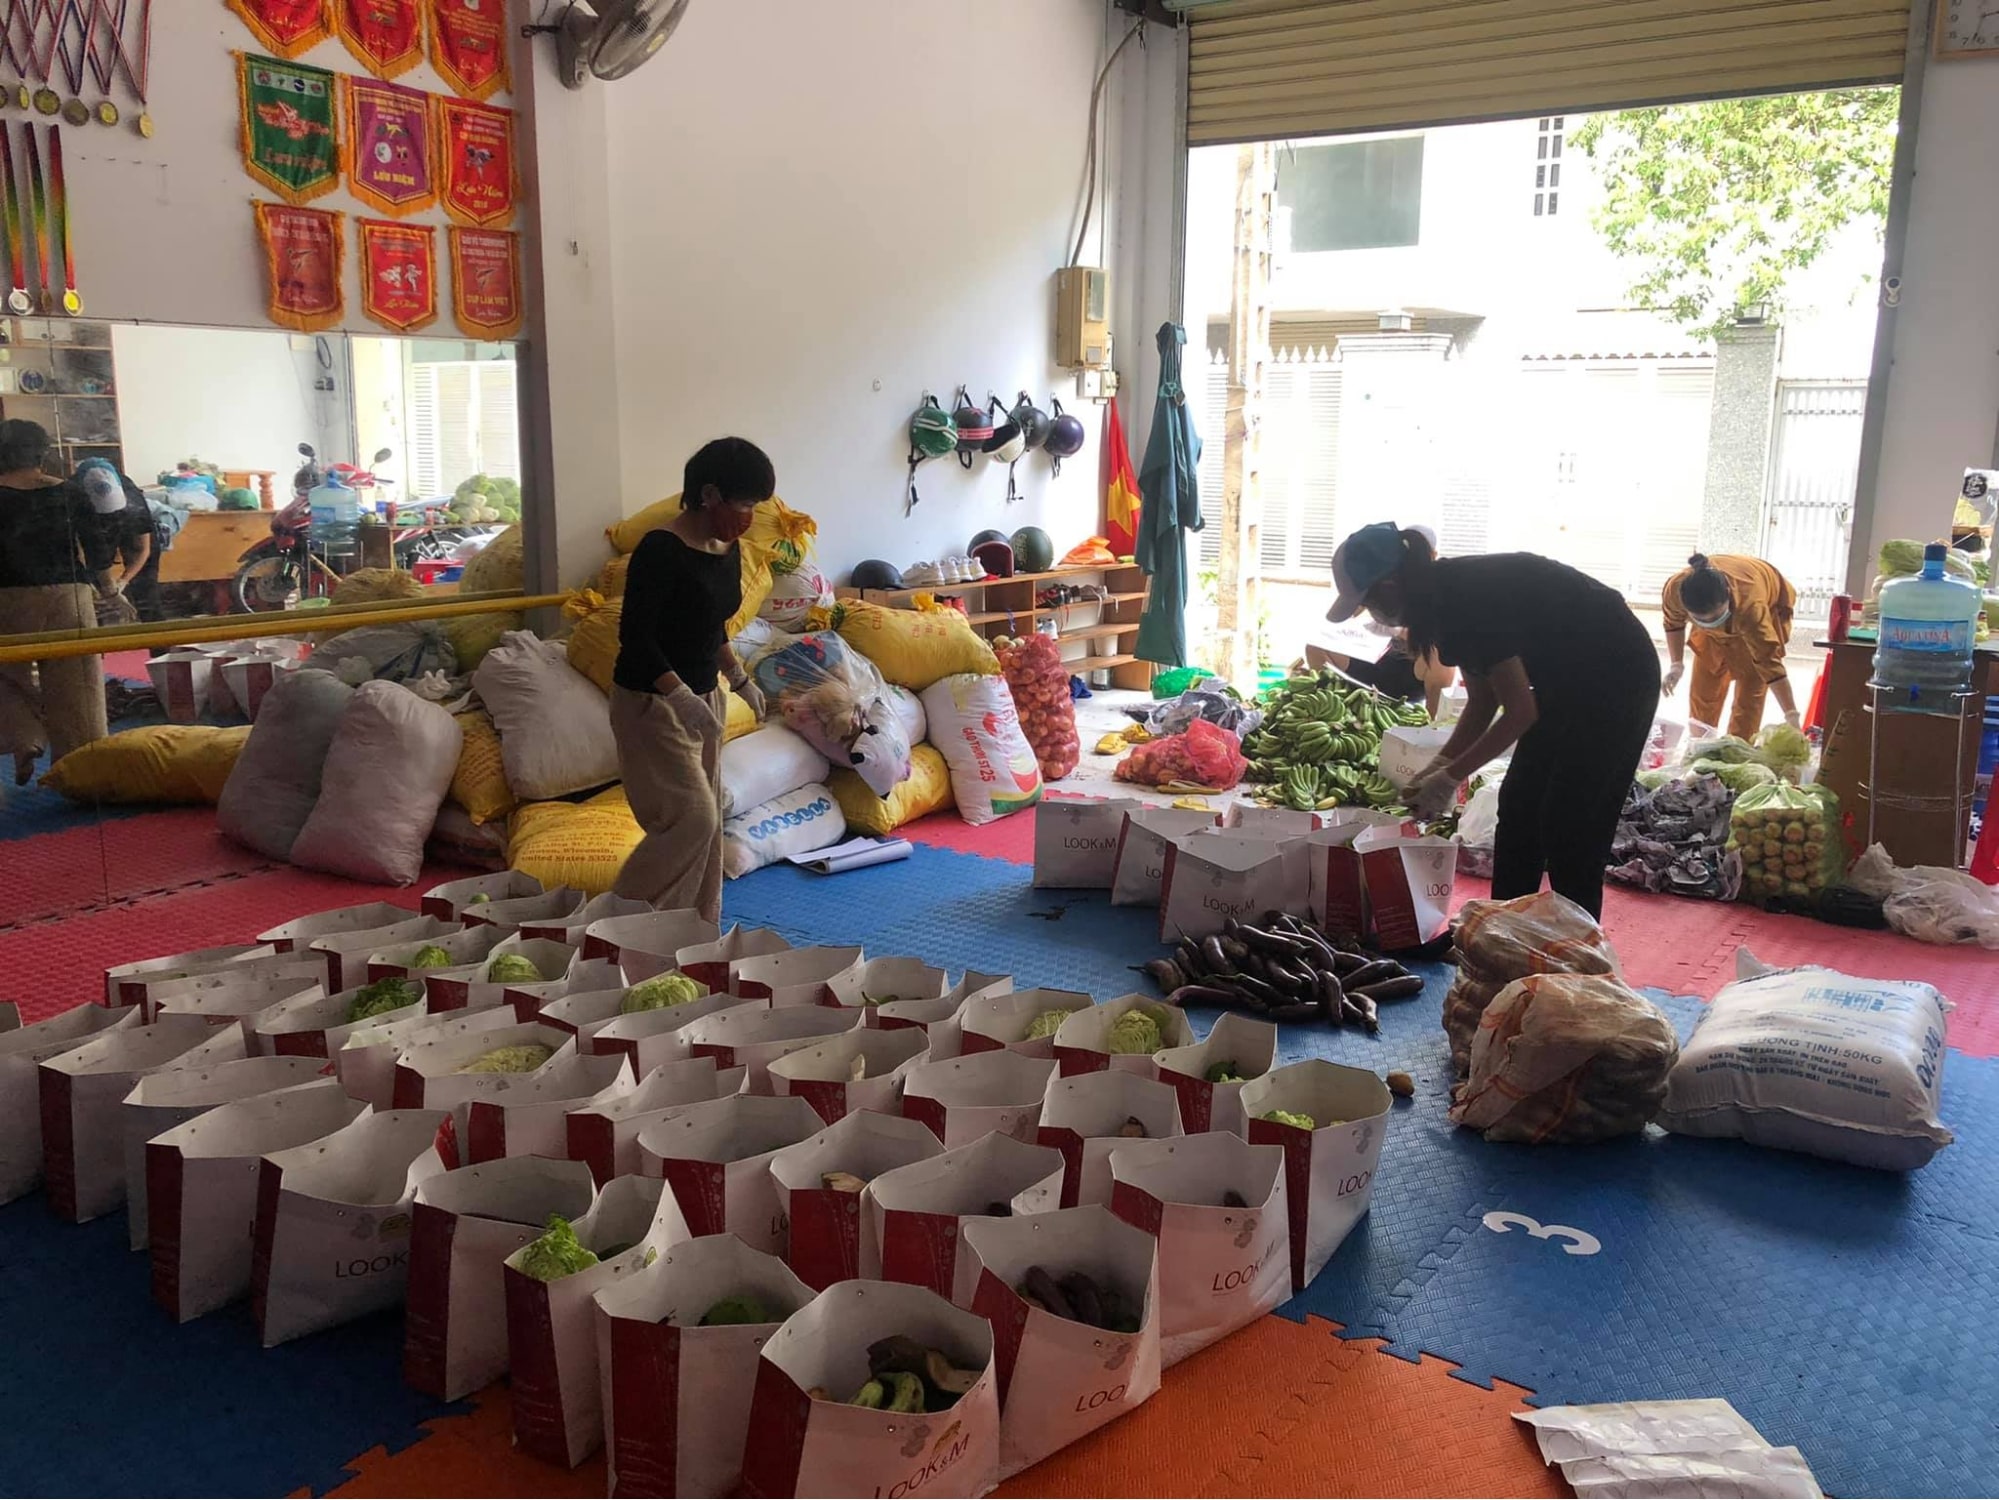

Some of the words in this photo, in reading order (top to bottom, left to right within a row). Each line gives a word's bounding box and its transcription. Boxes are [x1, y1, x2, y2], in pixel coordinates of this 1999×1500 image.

[1427, 883, 1450, 897] LOO
[1337, 1170, 1370, 1197] LOO
[1482, 1210, 1601, 1256] 3
[335, 1250, 409, 1278] LOOK
[1075, 1383, 1128, 1412] LOO
